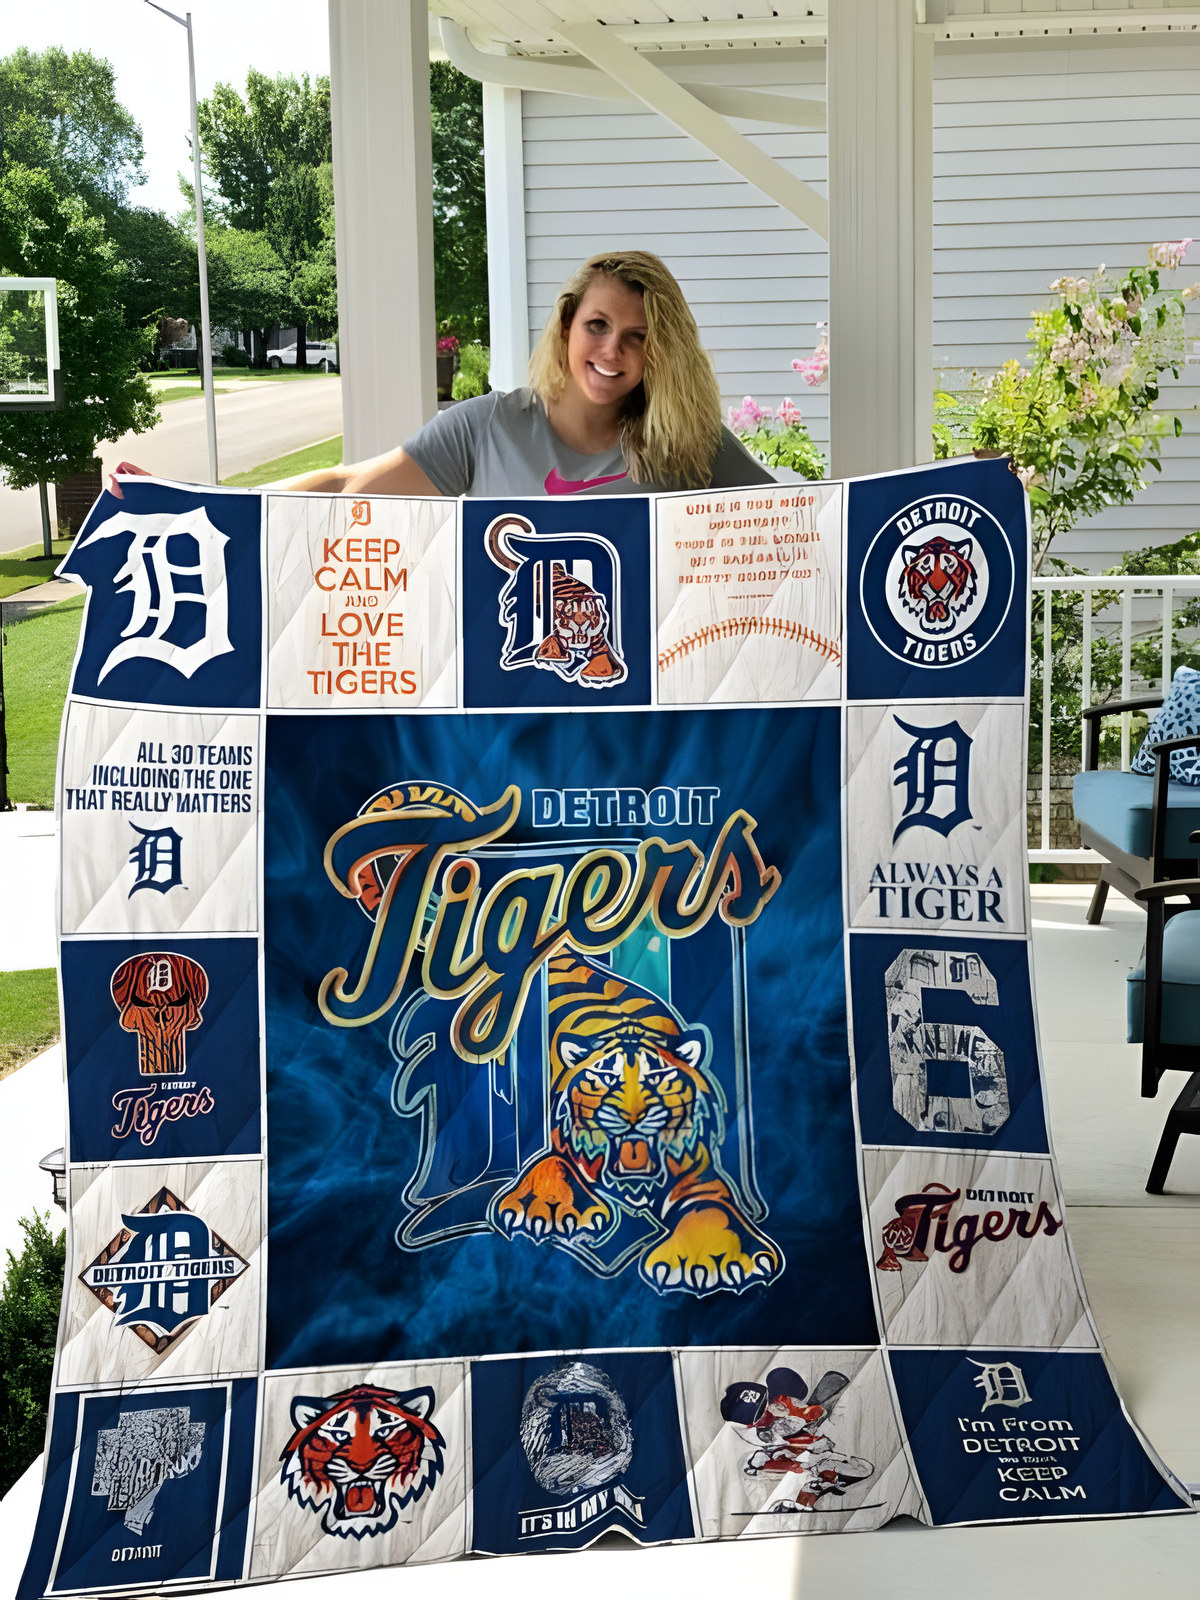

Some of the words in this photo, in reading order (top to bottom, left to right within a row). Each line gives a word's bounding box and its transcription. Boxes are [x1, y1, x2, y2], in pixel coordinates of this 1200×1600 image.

[323, 538, 400, 563] KEEP
[314, 566, 407, 592] CALM
[321, 612, 404, 636] LOVE
[332, 641, 391, 667] THE
[306, 669, 417, 695] TIGERS
[137, 741, 167, 764] ALL
[171, 744, 193, 765] 30
[197, 744, 253, 766] TEAMS
[92, 765, 180, 789] INCLUDING
[184, 769, 216, 789] THE
[219, 770, 253, 790] ONE
[66, 788, 107, 811] THAT
[111, 790, 172, 812] REALLY
[176, 792, 252, 813] MATTERS
[532, 786, 720, 828] DETROIT
[869, 862, 979, 887] ALWAYS
[986, 866, 1003, 888] A
[869, 885, 1005, 923] TIGER
[317, 784, 783, 1064] Tigers
[884, 948, 1010, 1135] 6
[895, 1186, 1063, 1274] Tigers
[957, 1417, 995, 1432] I'm
[1002, 1417, 1073, 1432] From
[962, 1437, 1080, 1453] DETROIT
[997, 1466, 1068, 1482] KEEP
[999, 1485, 1087, 1501] CALM
